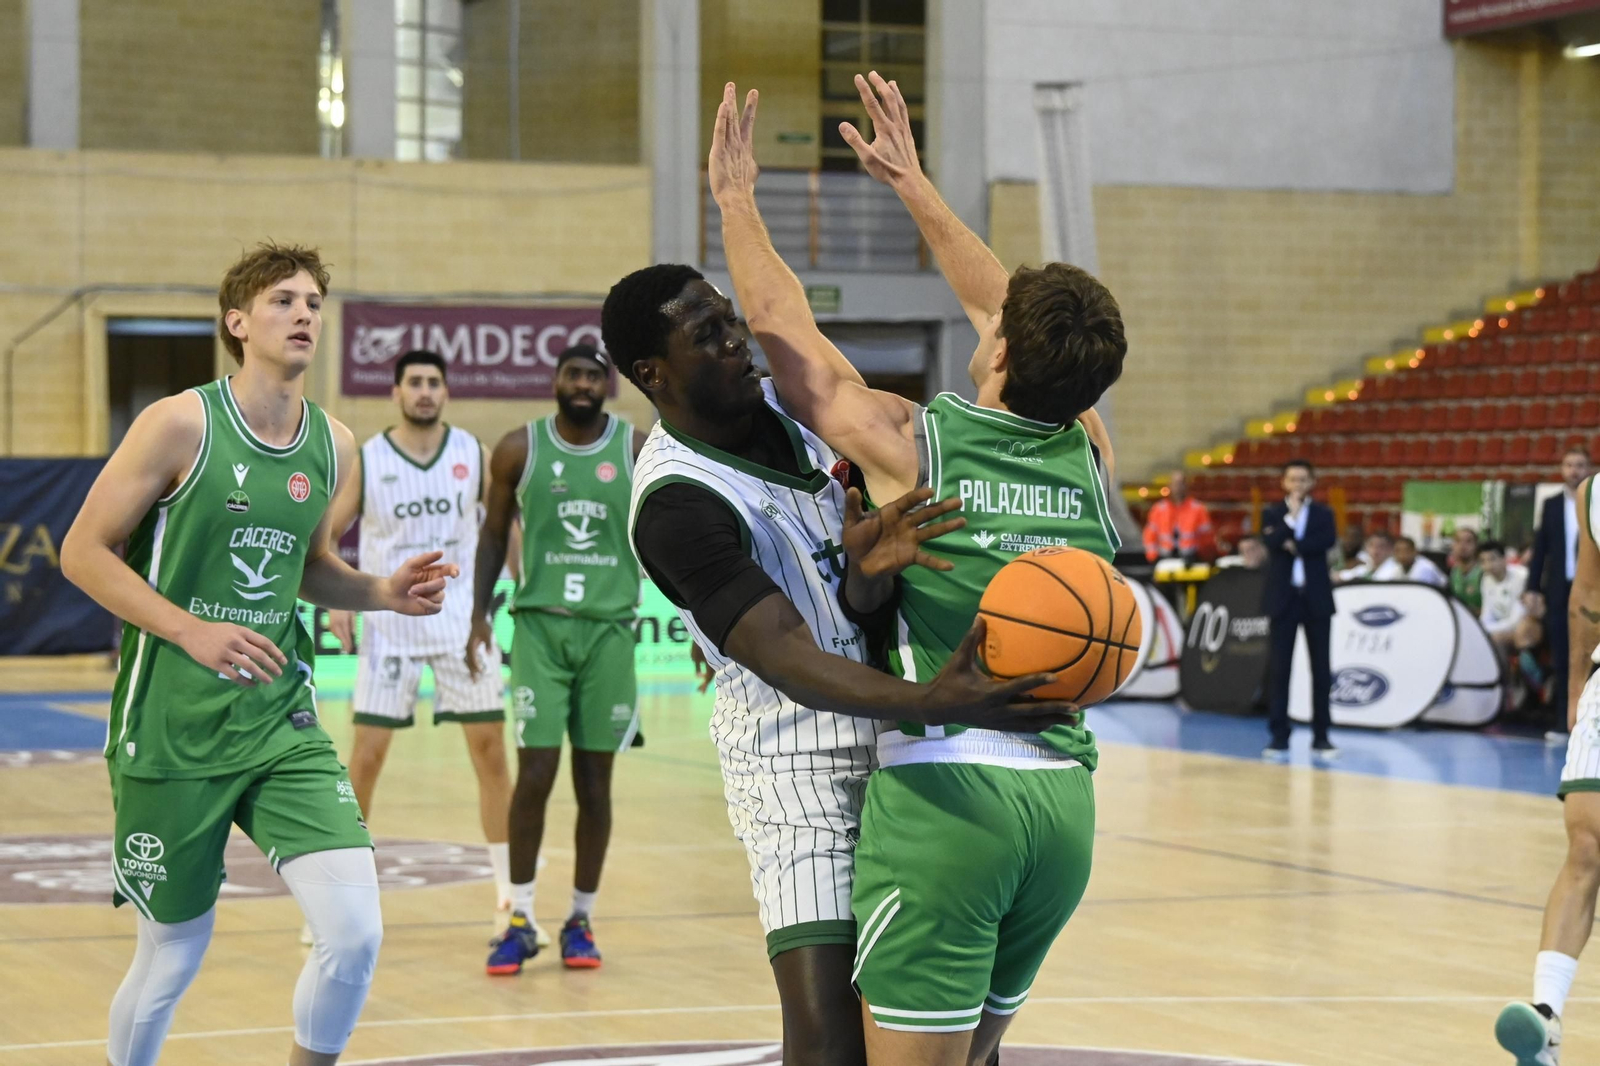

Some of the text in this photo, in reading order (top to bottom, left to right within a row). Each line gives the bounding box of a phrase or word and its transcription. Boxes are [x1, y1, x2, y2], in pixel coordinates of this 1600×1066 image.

[394, 497, 451, 519] coto
[959, 479, 1084, 520] PALAZUELOS
[229, 523, 296, 555] CÁCERES
[1000, 533, 1068, 547] CAJA RURAL DE
[563, 573, 585, 602] 5
[121, 868, 168, 882] NOVOMOTOR
[122, 858, 167, 874] TOYOTA
